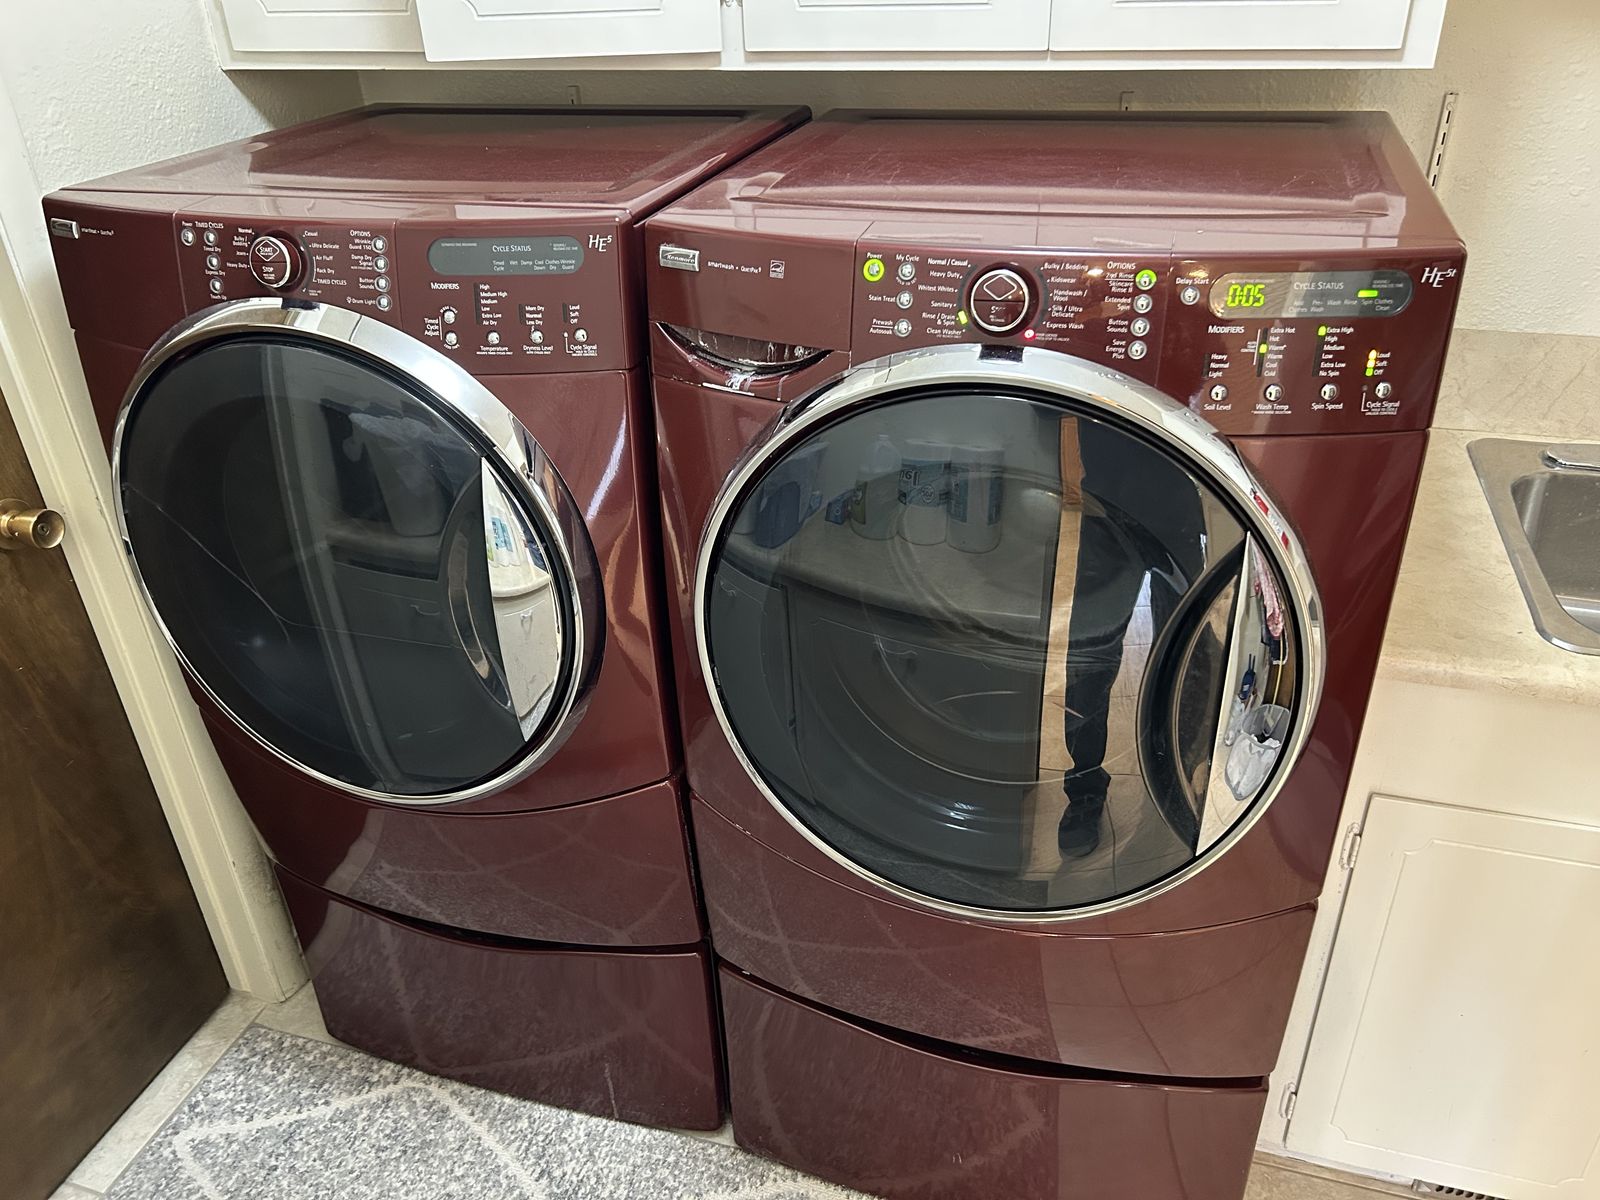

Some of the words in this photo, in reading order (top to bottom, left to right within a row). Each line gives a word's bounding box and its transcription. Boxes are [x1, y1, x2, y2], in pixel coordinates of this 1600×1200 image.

[209, 221, 224, 229] CYCLES
[667, 254, 695, 264] Kenmore
[896, 254, 904, 262] My
[906, 255, 920, 263] Cycle
[951, 259, 968, 267] Casual
[1044, 263, 1060, 272] Bulky
[1065, 263, 1089, 271] Bedding
[1107, 261, 1136, 270] OPTIONS
[930, 271, 945, 279] Heavy
[430, 282, 460, 290] MODIFIERS
[1176, 278, 1193, 286] Delay
[1194, 278, 1209, 286] Start
[1293, 282, 1315, 290] CYCLE
[1316, 281, 1344, 290] STATUS
[1226, 284, 1265, 307] 0:05
[931, 301, 953, 309] Sanitary
[424, 330, 440, 338] Adjust
[1208, 325, 1244, 334] MODIFIERS
[1211, 353, 1227, 361] Heavy
[1311, 402, 1325, 411] Spin
[1326, 402, 1344, 411] Speed
[1366, 402, 1381, 410] Cycle
[1382, 401, 1400, 409] Signal
